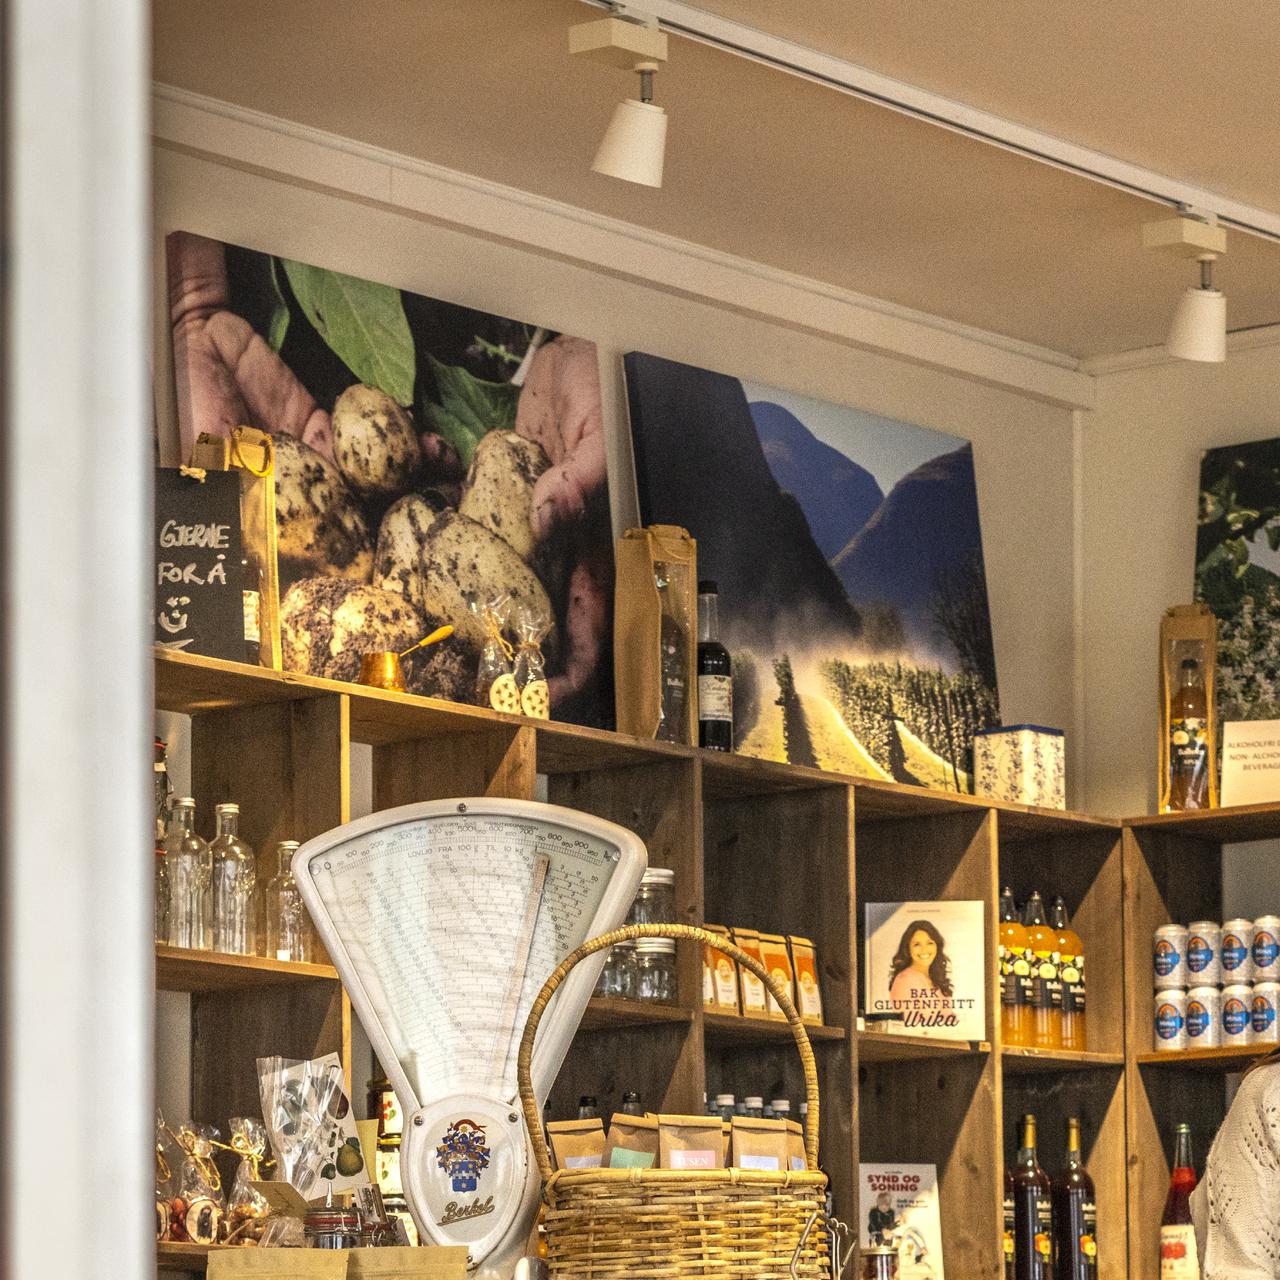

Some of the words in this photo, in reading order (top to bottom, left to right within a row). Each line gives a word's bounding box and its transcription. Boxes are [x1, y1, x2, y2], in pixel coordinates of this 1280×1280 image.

[159, 519, 231, 549] GJERNE
[157, 561, 205, 585] FOR
[1227, 739, 1276, 749] ALKOHOLFRI
[323, 861, 332, 871] 0
[345, 849, 358, 858] 100
[547, 832, 563, 842] 800
[574, 839, 589, 850] 900
[438, 845, 453, 854] FRA
[910, 988, 939, 999] BAK
[874, 999, 975, 1010] GLUTENFRITT
[867, 1174, 899, 1183] SYND
[902, 1174, 921, 1183] OG
[871, 1183, 918, 1192] SONING
[439, 1195, 496, 1226] Berkel
